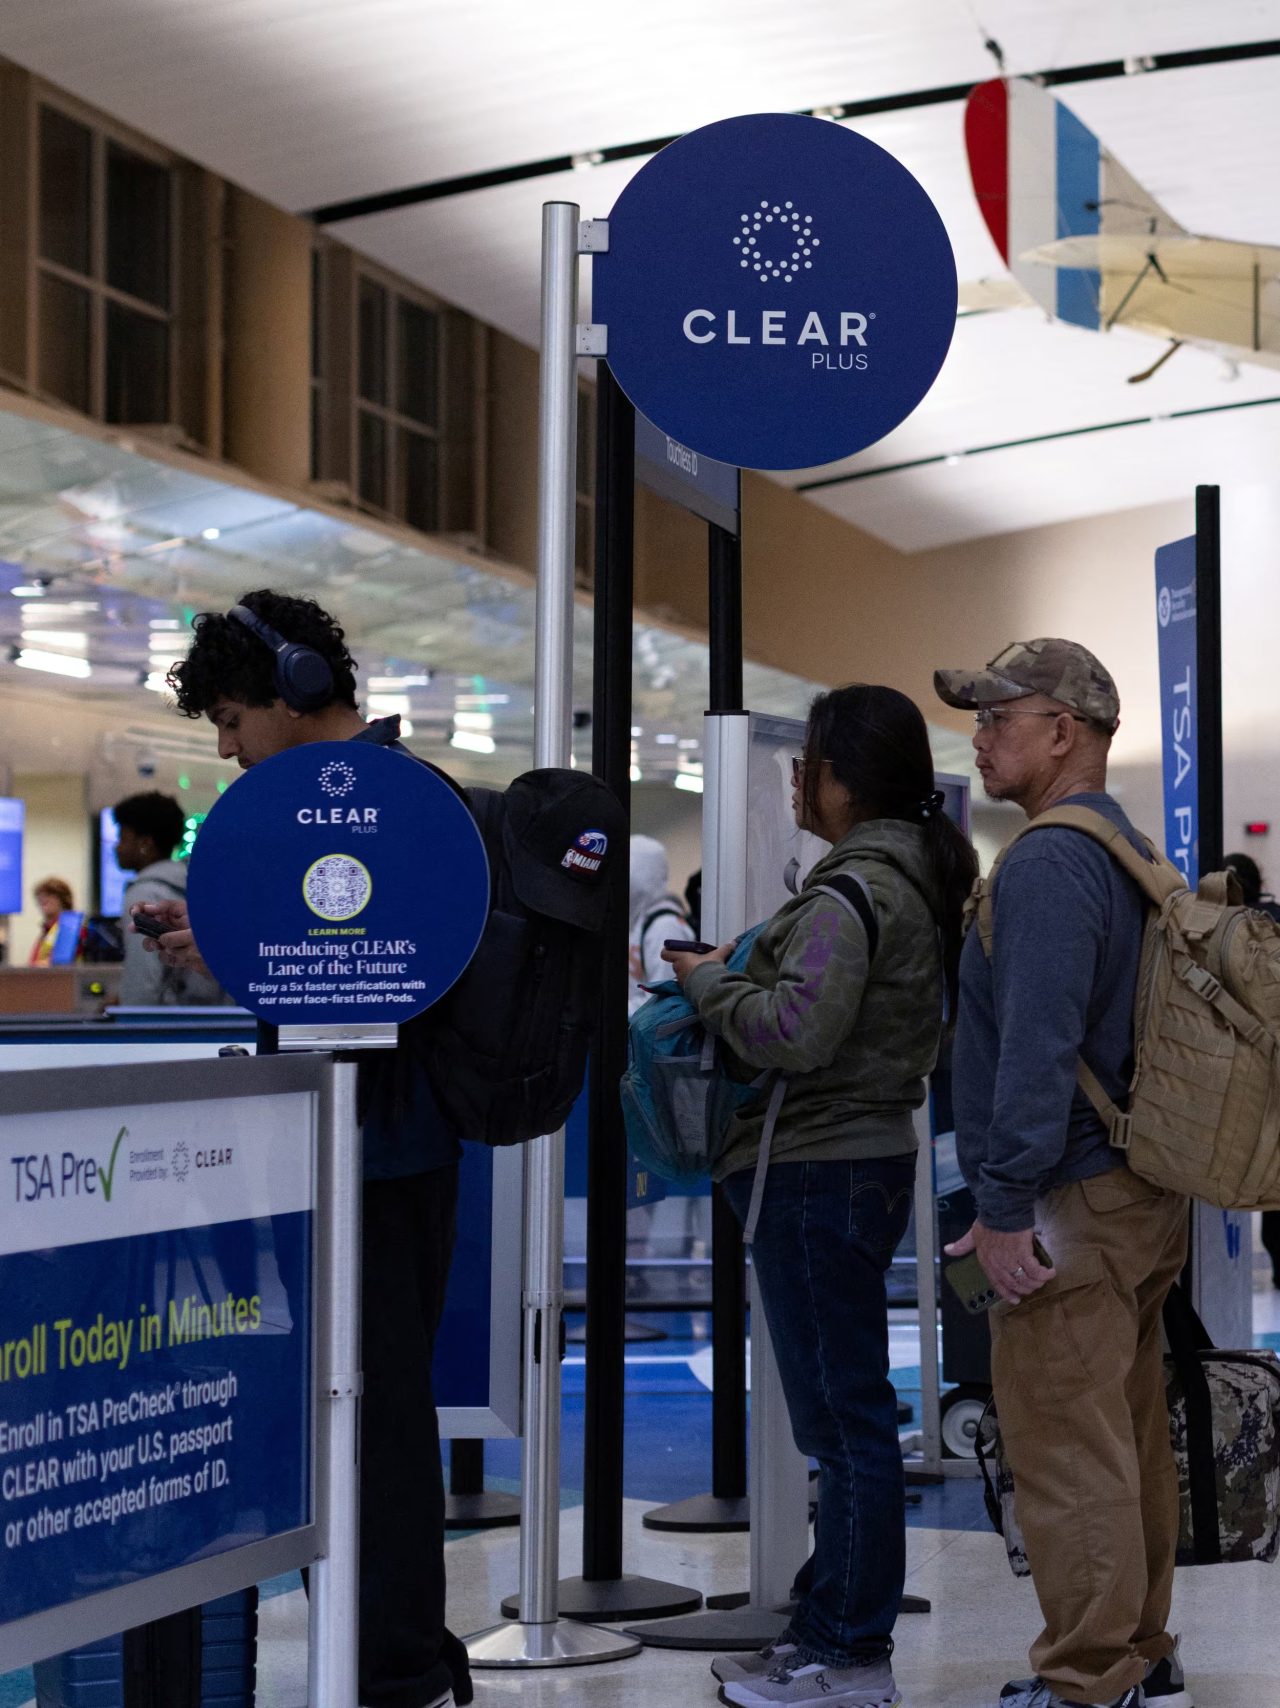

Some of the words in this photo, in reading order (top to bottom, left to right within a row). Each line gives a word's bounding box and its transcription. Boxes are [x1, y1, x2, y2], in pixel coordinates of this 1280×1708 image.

[812, 352, 868, 370] PLUS
[1173, 665, 1192, 790] TSA
[352, 825, 378, 834] PLUS
[308, 928, 338, 936] LEARN
[259, 941, 349, 959] Introducing
[268, 961, 305, 976] Lane
[307, 960, 326, 975] of
[328, 960, 353, 975] the
[356, 960, 407, 974] Future
[248, 983, 278, 993] Enjoy
[289, 982, 303, 992] 5x
[304, 981, 337, 991] faster
[339, 980, 400, 990] verification
[401, 980, 426, 989] with
[258, 997, 276, 1005] our
[279, 996, 301, 1004] new
[303, 994, 354, 1004] face-first
[356, 993, 383, 1003] EnVe
[385, 993, 416, 1003] Pods.
[195, 1149, 233, 1168] CLEAR
[11, 1154, 55, 1202] TSA
[61, 1152, 97, 1197] Pre
[53, 1313, 133, 1370] Today
[140, 1304, 161, 1352] in
[168, 1292, 262, 1347] Minutes
[0, 1413, 44, 1451] Enroll
[48, 1410, 63, 1441] in
[66, 1401, 100, 1437] TSA
[182, 1370, 237, 1408] through
[2, 1456, 59, 1500] CLEAR
[62, 1449, 97, 1485] with
[101, 1443, 135, 1482] your
[138, 1430, 167, 1464] U.S.
[170, 1415, 233, 1464] passport
[5, 1521, 24, 1549] or
[26, 1506, 70, 1543] other
[74, 1480, 146, 1526] accepted
[149, 1474, 191, 1507] forms
[194, 1461, 209, 1493] of
[211, 1458, 229, 1488] ID.
